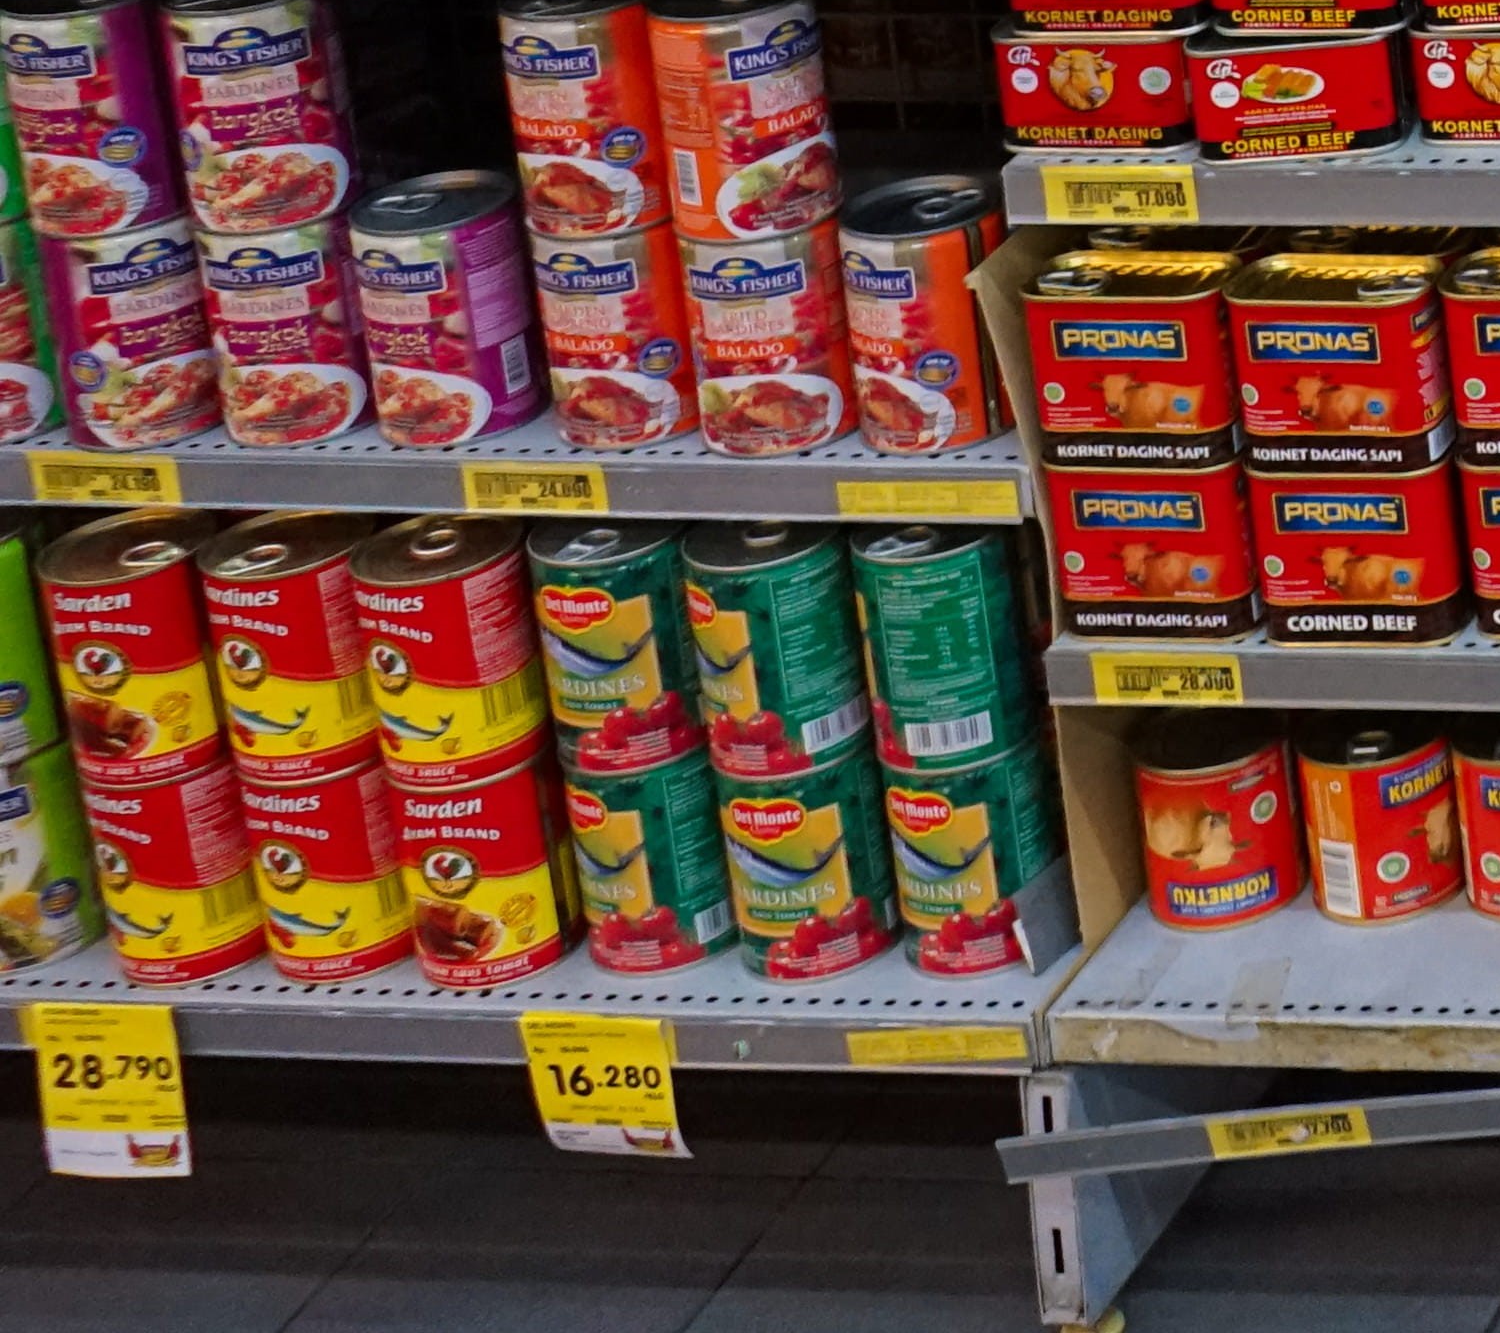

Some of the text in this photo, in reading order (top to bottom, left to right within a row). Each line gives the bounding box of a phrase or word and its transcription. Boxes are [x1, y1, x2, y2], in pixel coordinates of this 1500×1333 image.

[693, 269, 796, 295] KING'S FISHER
[718, 342, 782, 356] BALADO
[405, 798, 481, 818] Sarden
[733, 808, 800, 825] Del Monte
[53, 1055, 171, 1087] 28.790
[551, 1066, 660, 1095] 16.280
